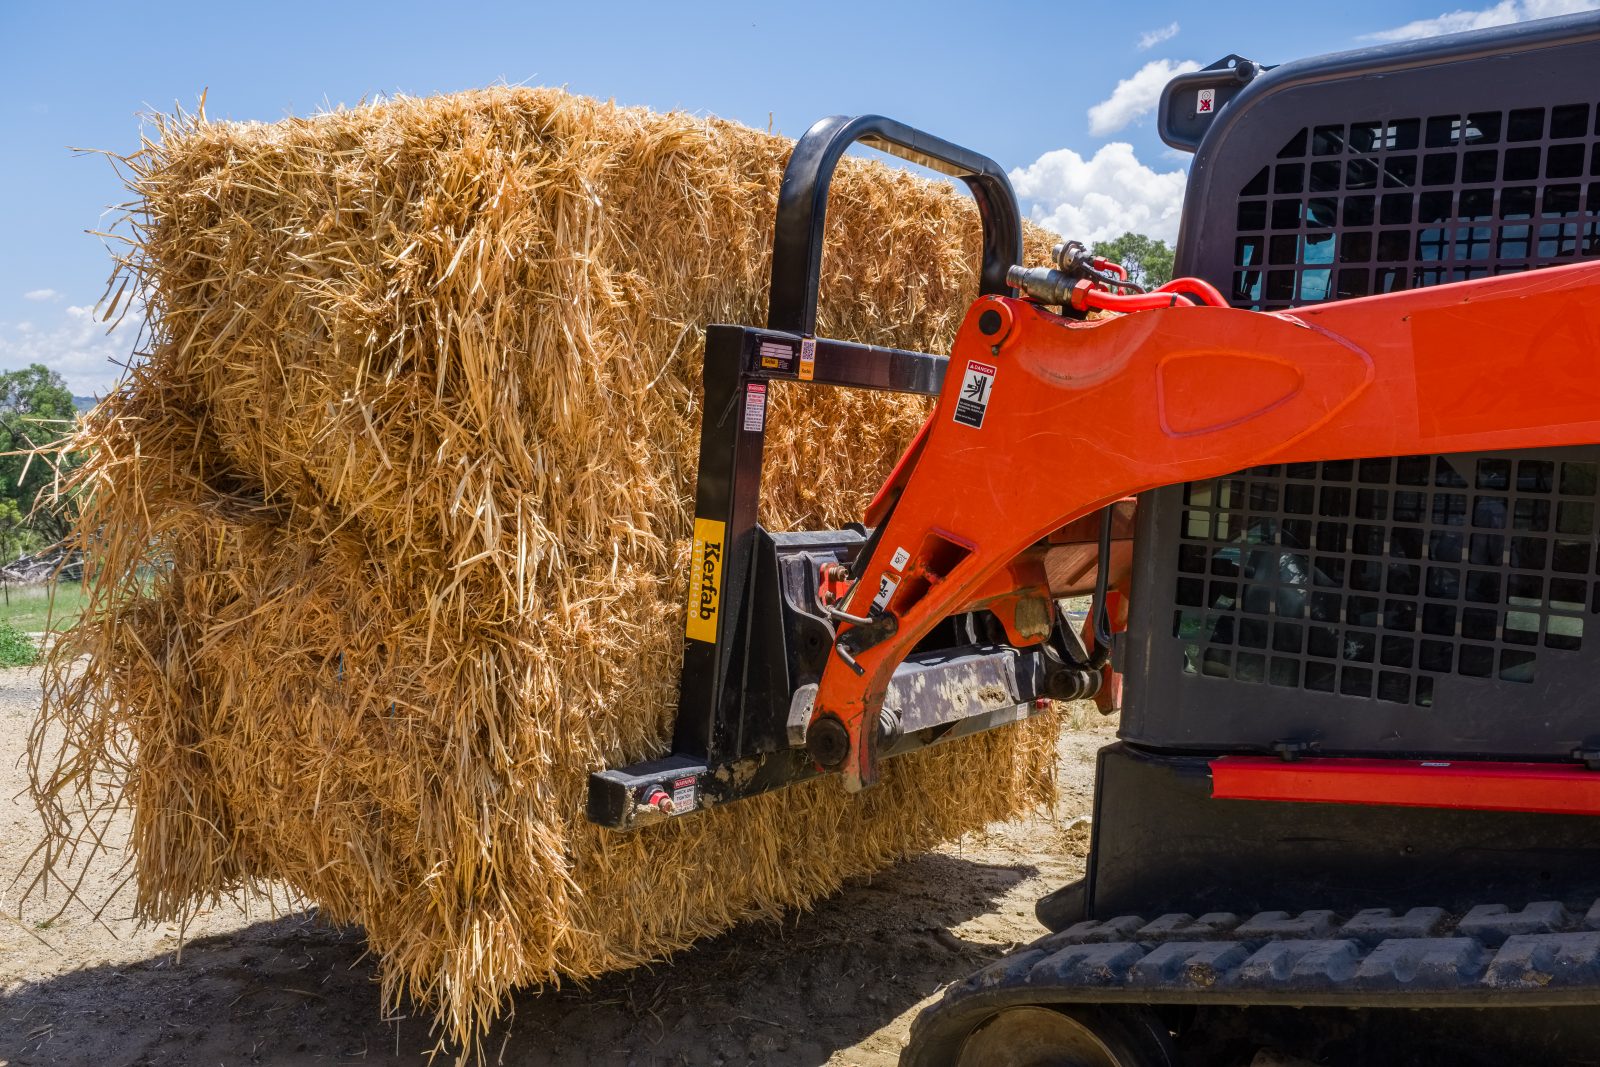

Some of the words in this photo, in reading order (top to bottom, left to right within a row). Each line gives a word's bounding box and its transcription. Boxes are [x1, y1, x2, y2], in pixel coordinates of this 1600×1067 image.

[974, 365, 994, 375] DANGER
[699, 541, 722, 621] Kerfab
[675, 777, 696, 787] WARNING
